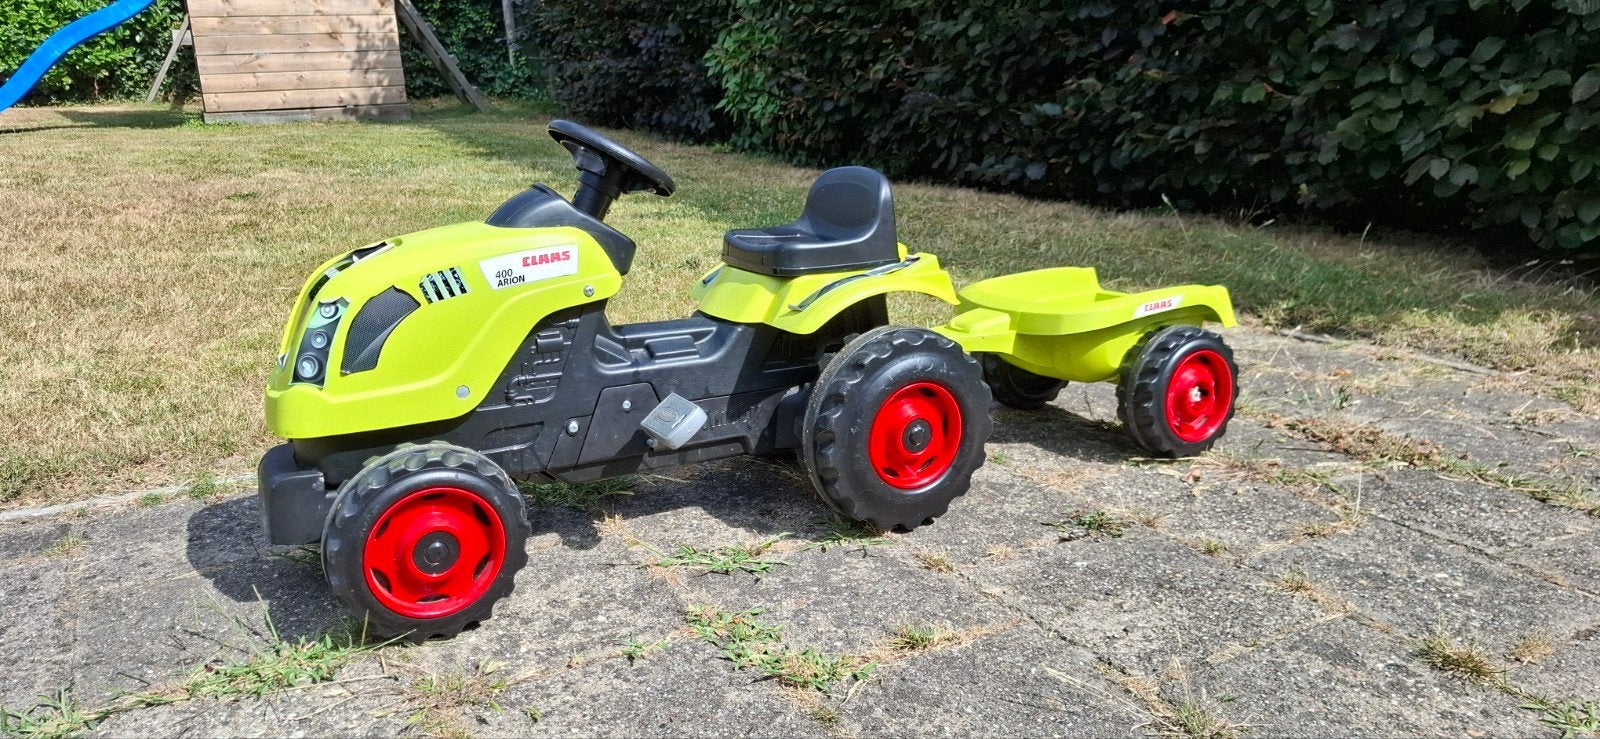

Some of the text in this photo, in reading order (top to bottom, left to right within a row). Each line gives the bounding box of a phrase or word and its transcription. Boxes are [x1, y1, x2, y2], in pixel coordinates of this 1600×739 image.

[522, 251, 571, 267] CLAAS
[495, 268, 513, 279] 400
[497, 275, 525, 287] ARION
[1144, 300, 1172, 311] CLAAS
